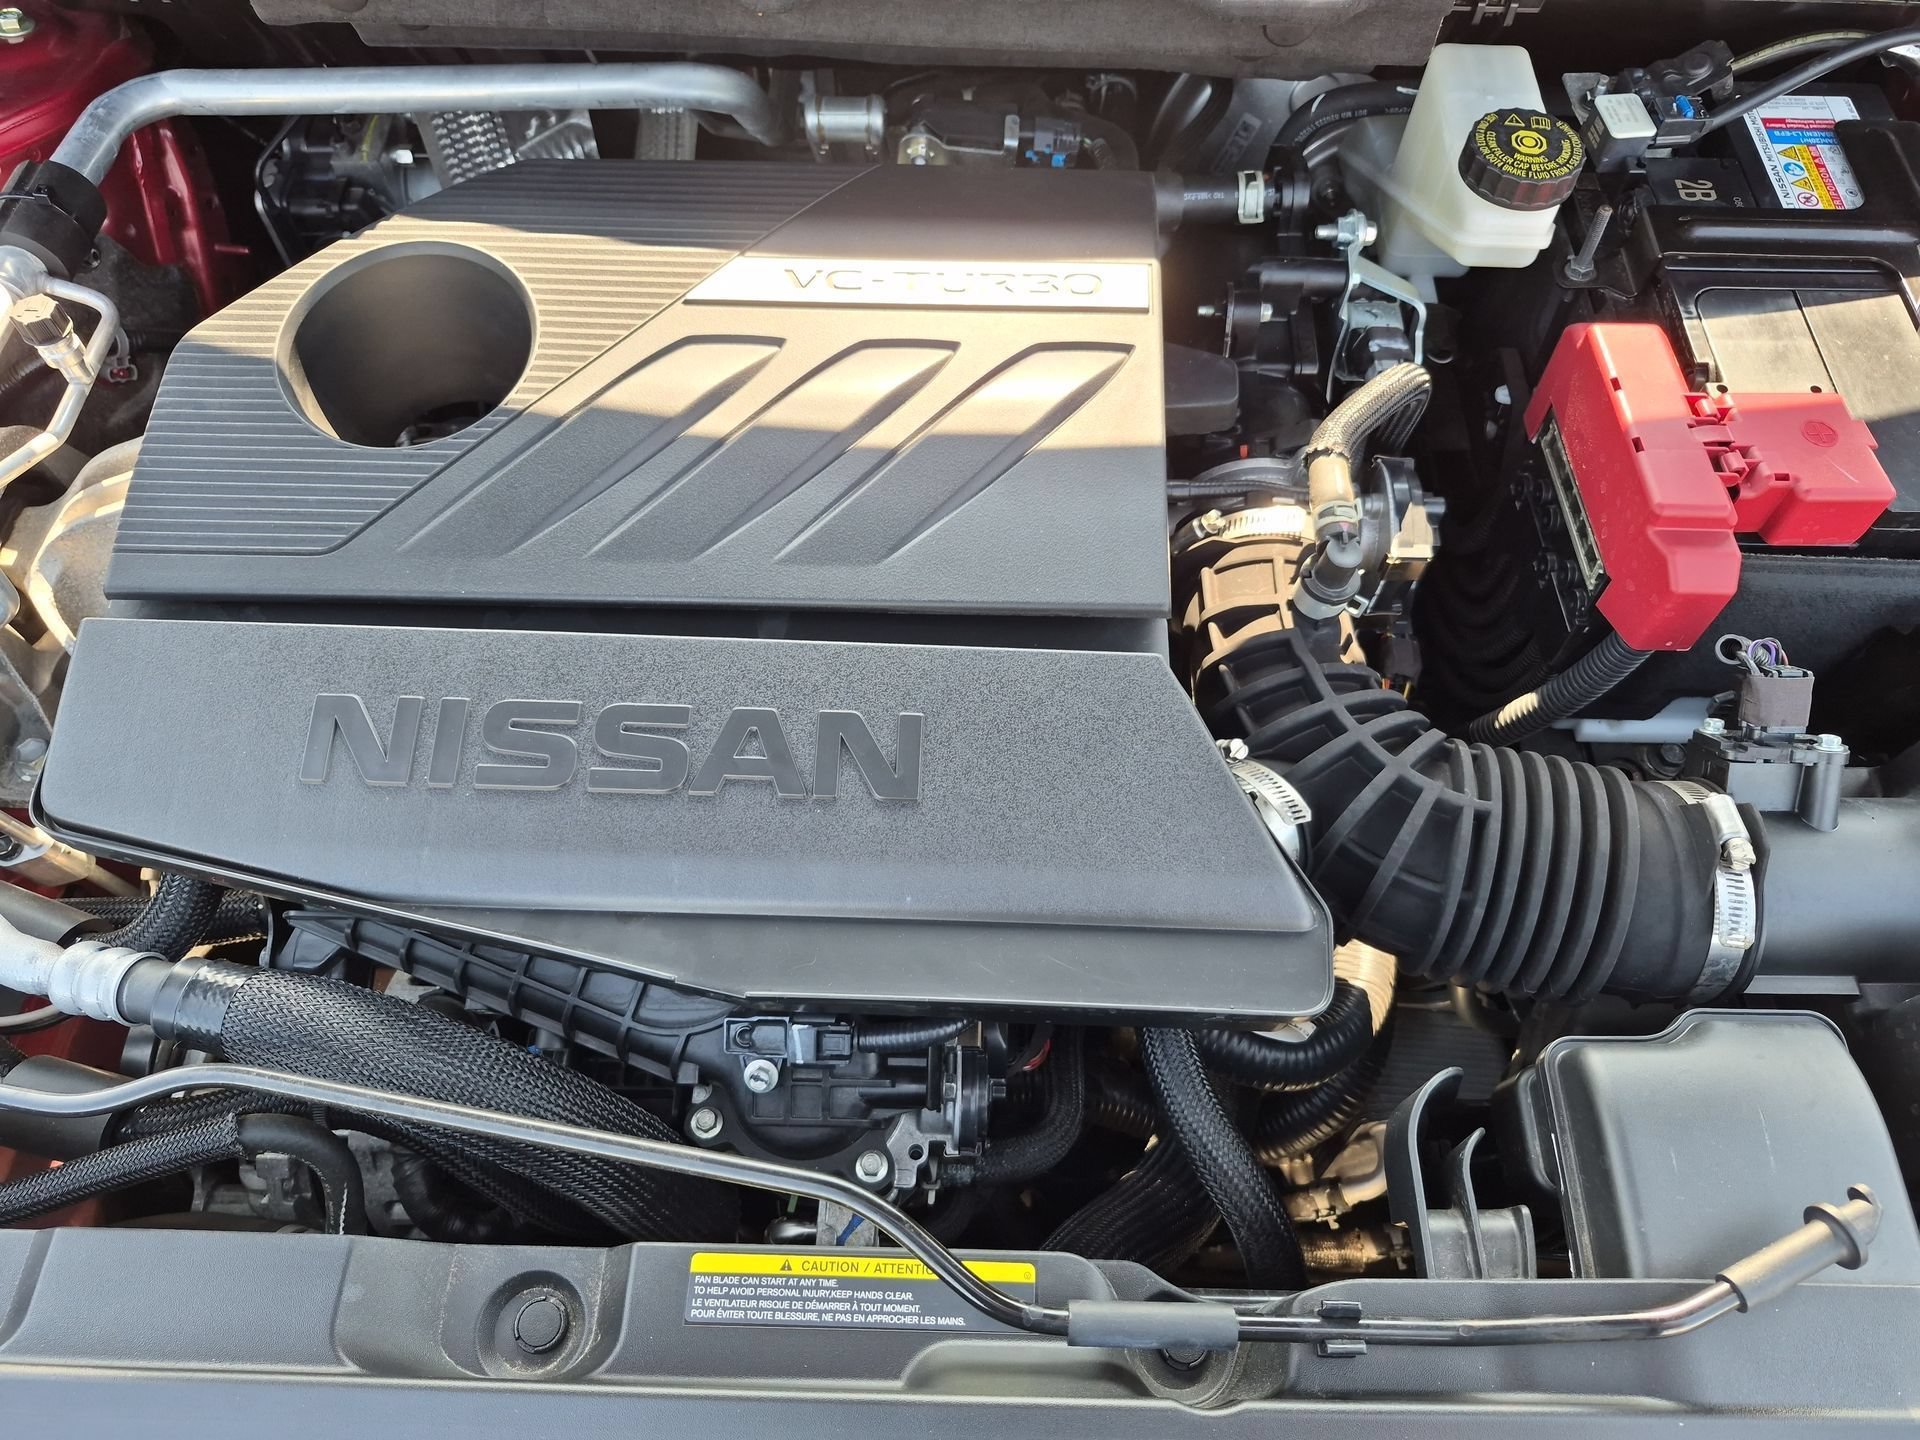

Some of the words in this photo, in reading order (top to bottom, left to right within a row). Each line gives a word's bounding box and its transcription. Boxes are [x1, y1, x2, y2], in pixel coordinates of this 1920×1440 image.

[1486, 130, 1498, 148] CLEAN
[1754, 126, 1773, 162] MITSUBISHI
[1491, 147, 1514, 165] FILLER
[1513, 152, 1549, 163] WARNING
[1502, 164, 1527, 177] BRAKE
[1528, 170, 1551, 179] FLUID
[1549, 166, 1570, 178] FROM
[1513, 160, 1530, 169] CAP
[1530, 160, 1560, 171] BEFORE
[1770, 164, 1792, 199] NISSAN
[1674, 179, 1718, 202] 2B
[784, 268, 1103, 295] VC-TURBO
[299, 692, 926, 800] NISSAN
[801, 1260, 859, 1273] CAUTION
[695, 1275, 712, 1284] FAN
[713, 1276, 740, 1285] BLADE
[741, 1276, 760, 1285] CAN
[761, 1277, 787, 1286] START
[788, 1277, 799, 1286] AT
[799, 1278, 817, 1287] ANY
[818, 1278, 839, 1288] TIME.
[694, 1286, 705, 1295] TO
[707, 1286, 728, 1295] HELP
[729, 1287, 755, 1296] AVOID
[756, 1287, 801, 1297] PERSONAL
[853, 1291, 884, 1300] HANDS
[884, 1292, 914, 1301] CLEAR.
[692, 1298, 702, 1307] LE
[704, 1299, 758, 1308] VENTILATEUR
[758, 1300, 790, 1309] RISQUE
[791, 1301, 803, 1310] DE
[804, 1299, 851, 1311] DÉMARRER
[851, 1301, 859, 1311] À
[859, 1303, 882, 1312] TOUT
[883, 1304, 921, 1313] MOMENT.
[690, 1309, 716, 1318] POUR
[716, 1307, 745, 1319] ÉVITER
[746, 1310, 773, 1320] TOUTE
[774, 1311, 820, 1322] BLESSURE,
[821, 1313, 834, 1322] NE
[835, 1313, 852, 1322] PAS
[853, 1314, 865, 1323] EN
[865, 1314, 919, 1324] APPROCHER
[920, 1316, 936, 1325] LES
[937, 1317, 966, 1326] MAINS.
